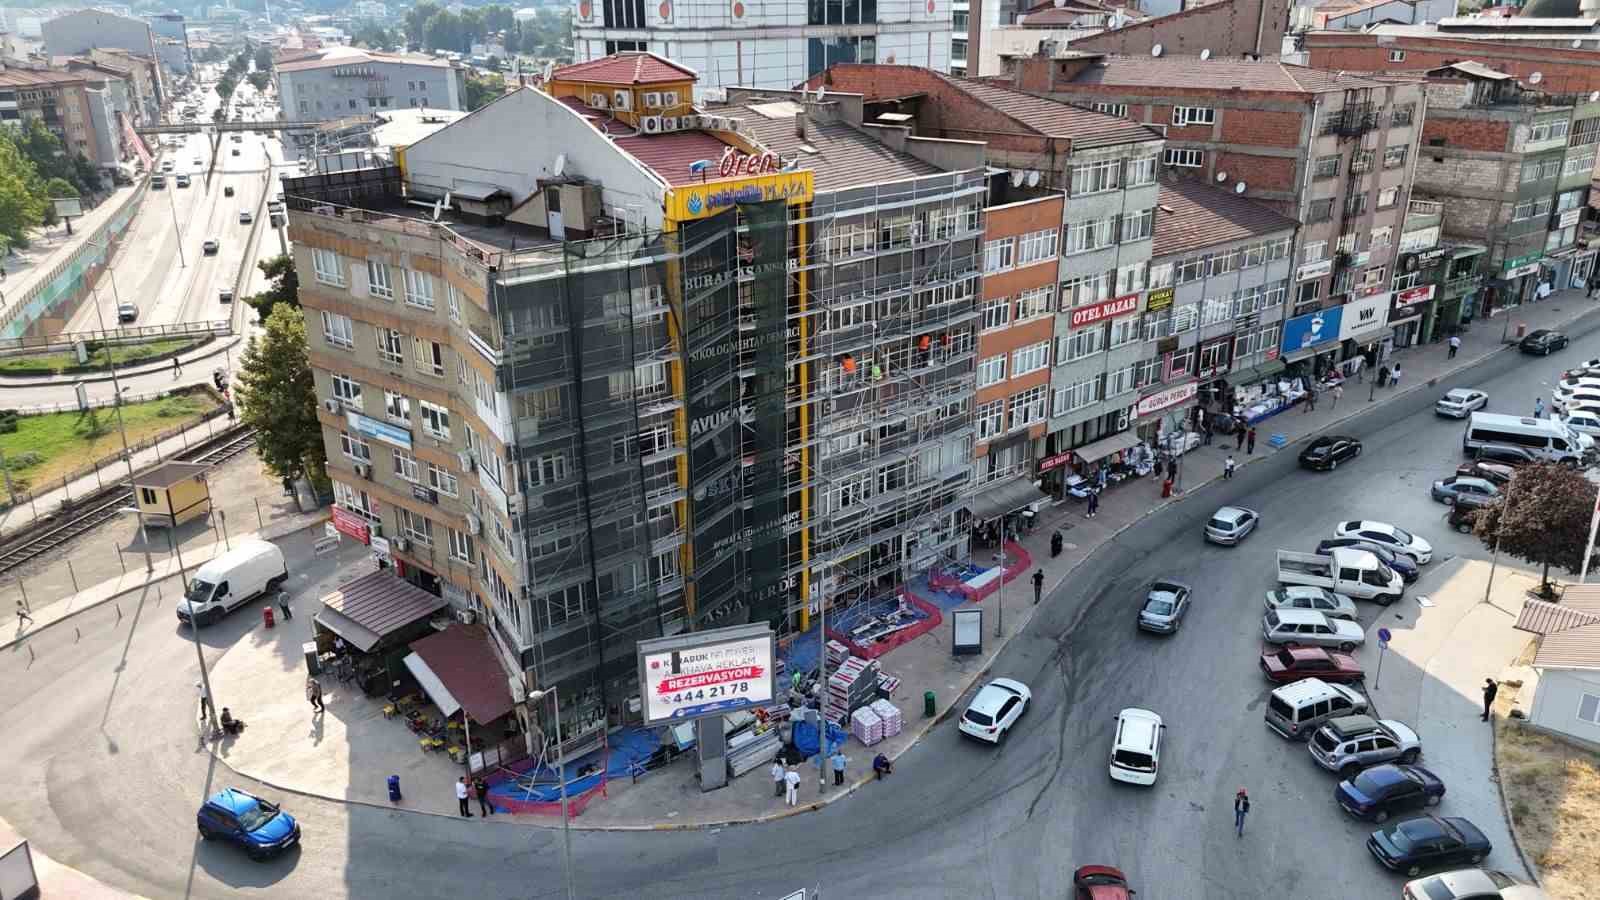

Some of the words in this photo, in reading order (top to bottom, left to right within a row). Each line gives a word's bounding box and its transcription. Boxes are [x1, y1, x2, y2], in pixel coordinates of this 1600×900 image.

[719, 147, 774, 177] Ören
[1073, 309, 1100, 324] OTEL
[1102, 298, 1136, 317] NAZAR
[704, 599, 745, 625] ASYA
[716, 656, 756, 670] REKLAM
[668, 667, 752, 689] REZERVASYON
[673, 689, 704, 703] 444
[710, 686, 725, 698] 21
[730, 682, 749, 694] 78
